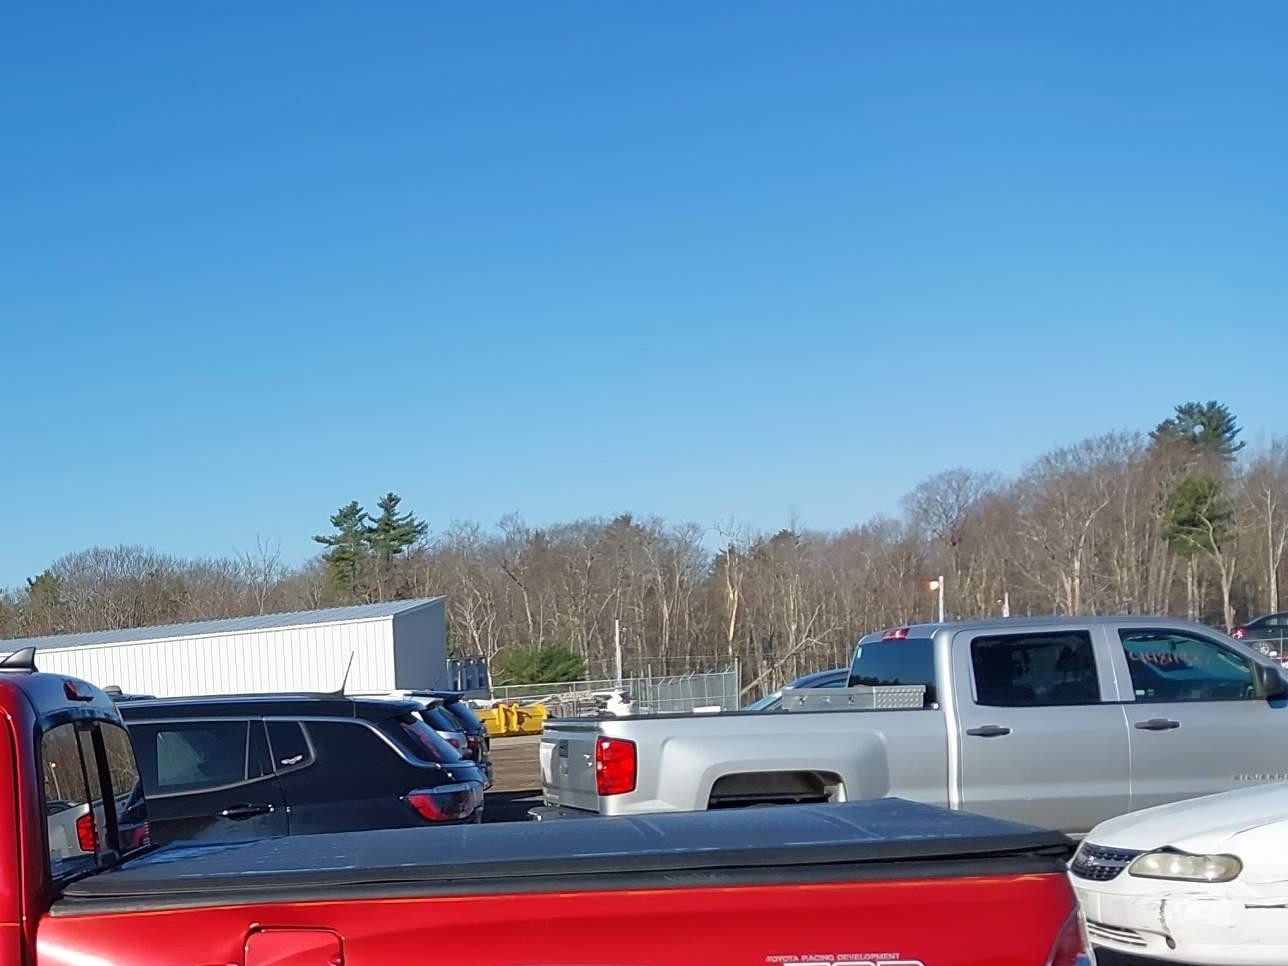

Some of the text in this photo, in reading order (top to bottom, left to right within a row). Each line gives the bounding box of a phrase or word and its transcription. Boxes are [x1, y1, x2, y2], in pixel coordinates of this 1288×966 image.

[765, 952, 900, 963] TOYOTA RACING DEVELOPMENT
